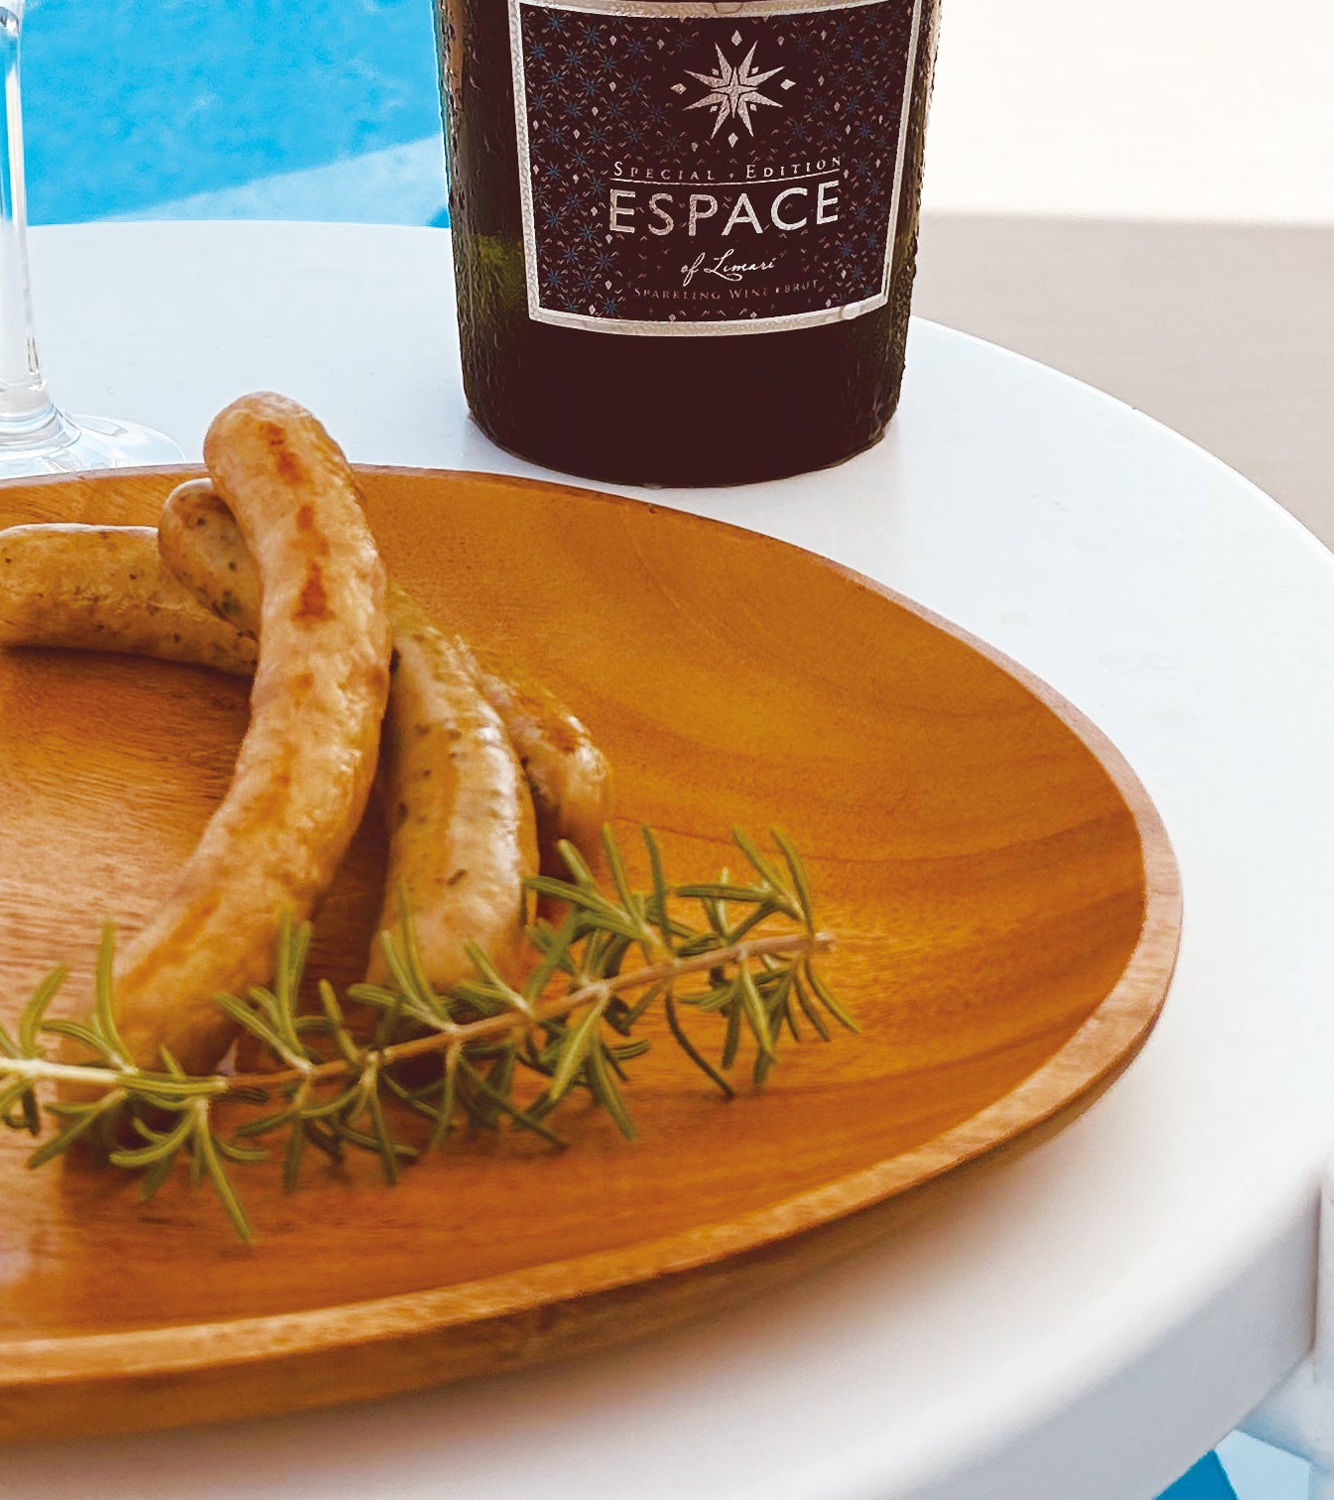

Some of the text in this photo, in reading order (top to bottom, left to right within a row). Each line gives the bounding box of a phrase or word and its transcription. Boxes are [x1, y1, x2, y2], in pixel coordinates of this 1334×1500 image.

[609, 180, 840, 236] ESPACE
[680, 251, 706, 287] of
[783, 279, 819, 294] BRUT
